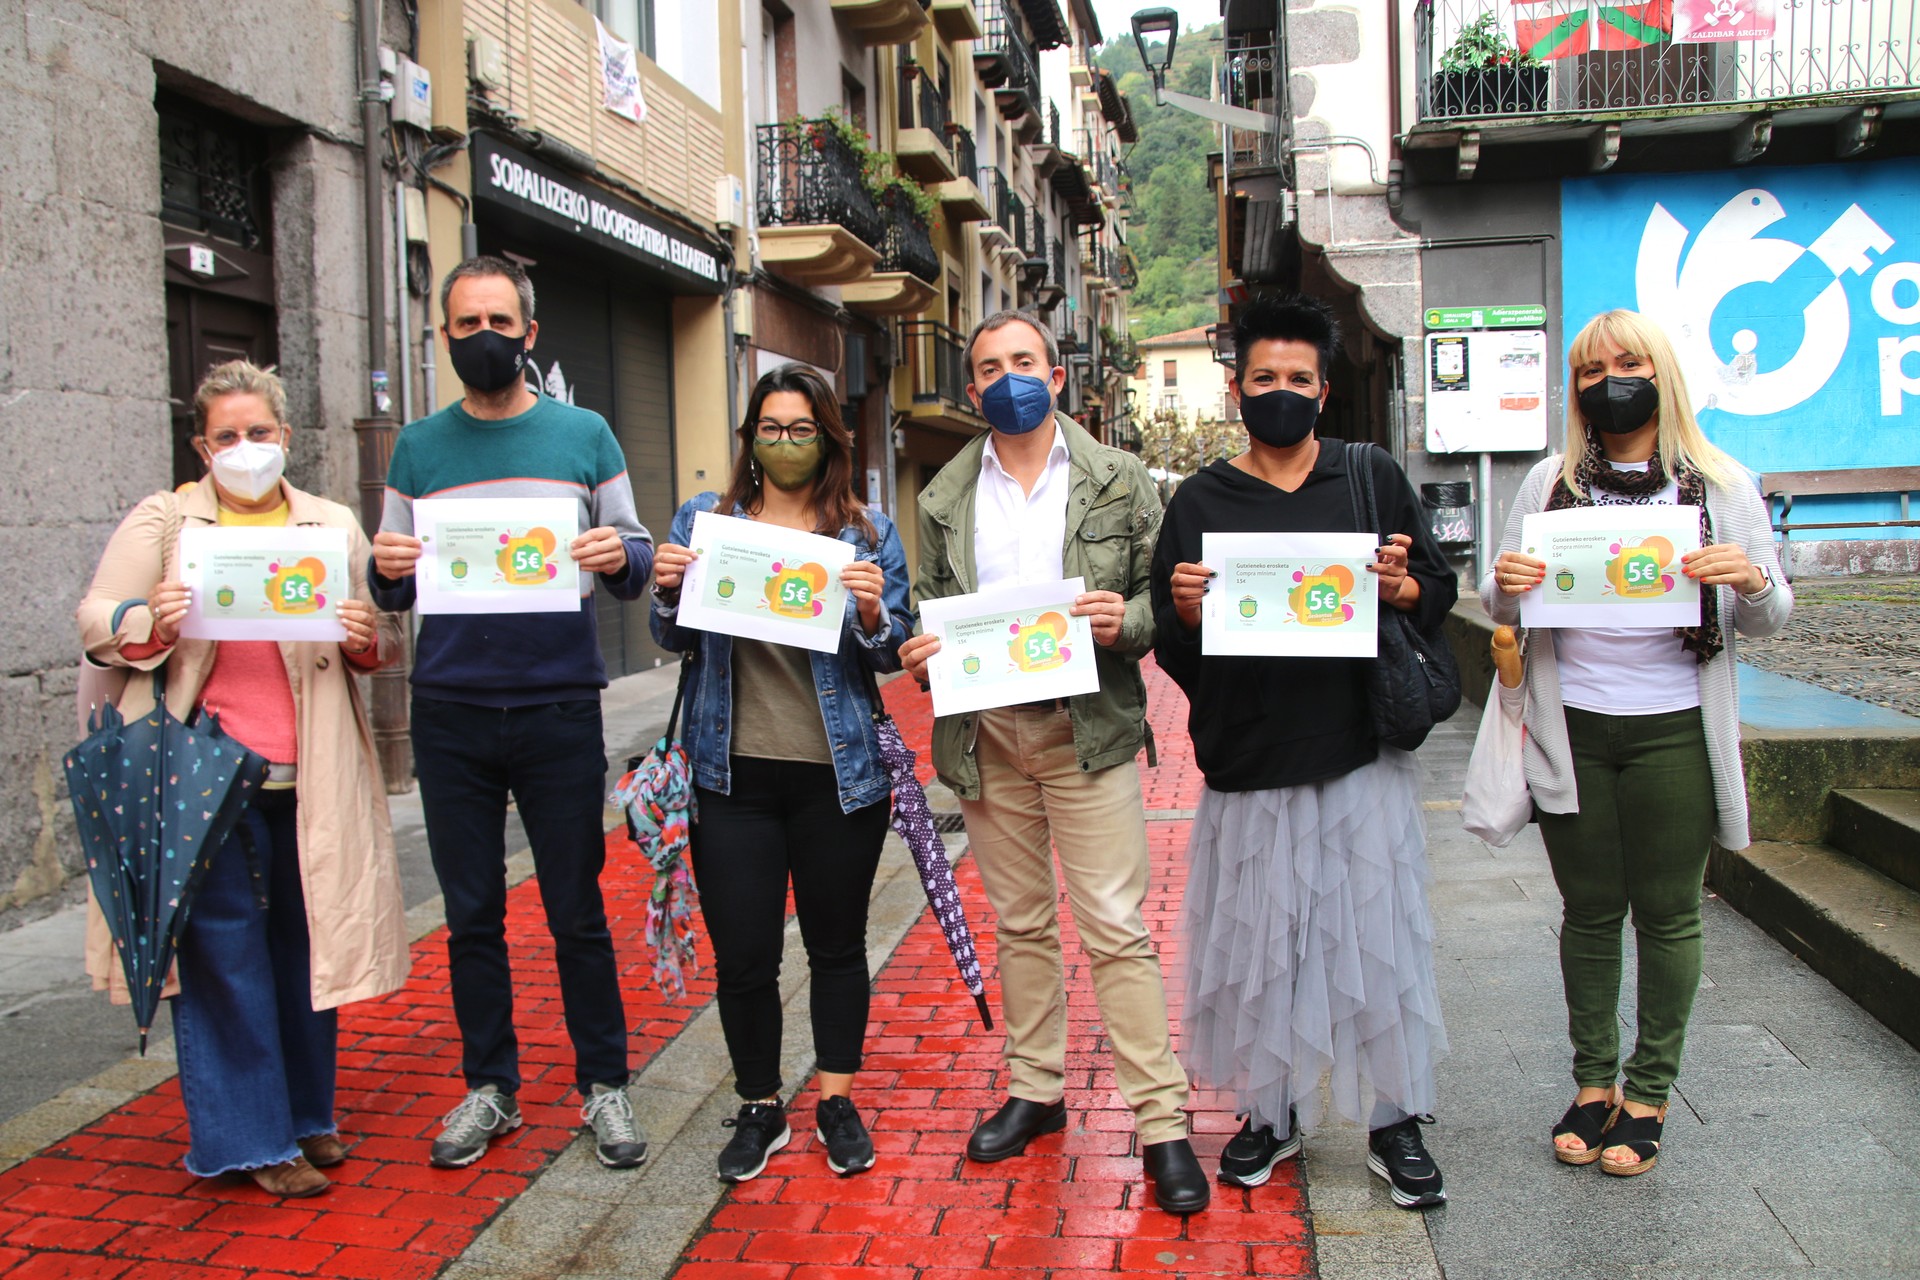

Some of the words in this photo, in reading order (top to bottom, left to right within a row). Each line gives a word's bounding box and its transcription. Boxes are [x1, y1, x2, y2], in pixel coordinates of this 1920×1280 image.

[1692, 31, 1735, 39] ZALDIBAR
[1736, 29, 1769, 37] ARGITU
[490, 152, 589, 225] SORALUZEKO
[591, 200, 671, 261] KOOPERATIBA
[670, 238, 718, 282] ELKARTEA
[516, 551, 540, 570] 5€
[720, 551, 739, 561] Compra
[1628, 561, 1655, 583] 5€
[283, 580, 309, 600] 5€
[782, 582, 809, 603] 5€
[1309, 590, 1336, 611] 5€
[955, 621, 983, 631] Gutxieneko
[983, 618, 1005, 627] erosketa
[956, 630, 975, 638] Compra
[1029, 637, 1054, 658] 5€
